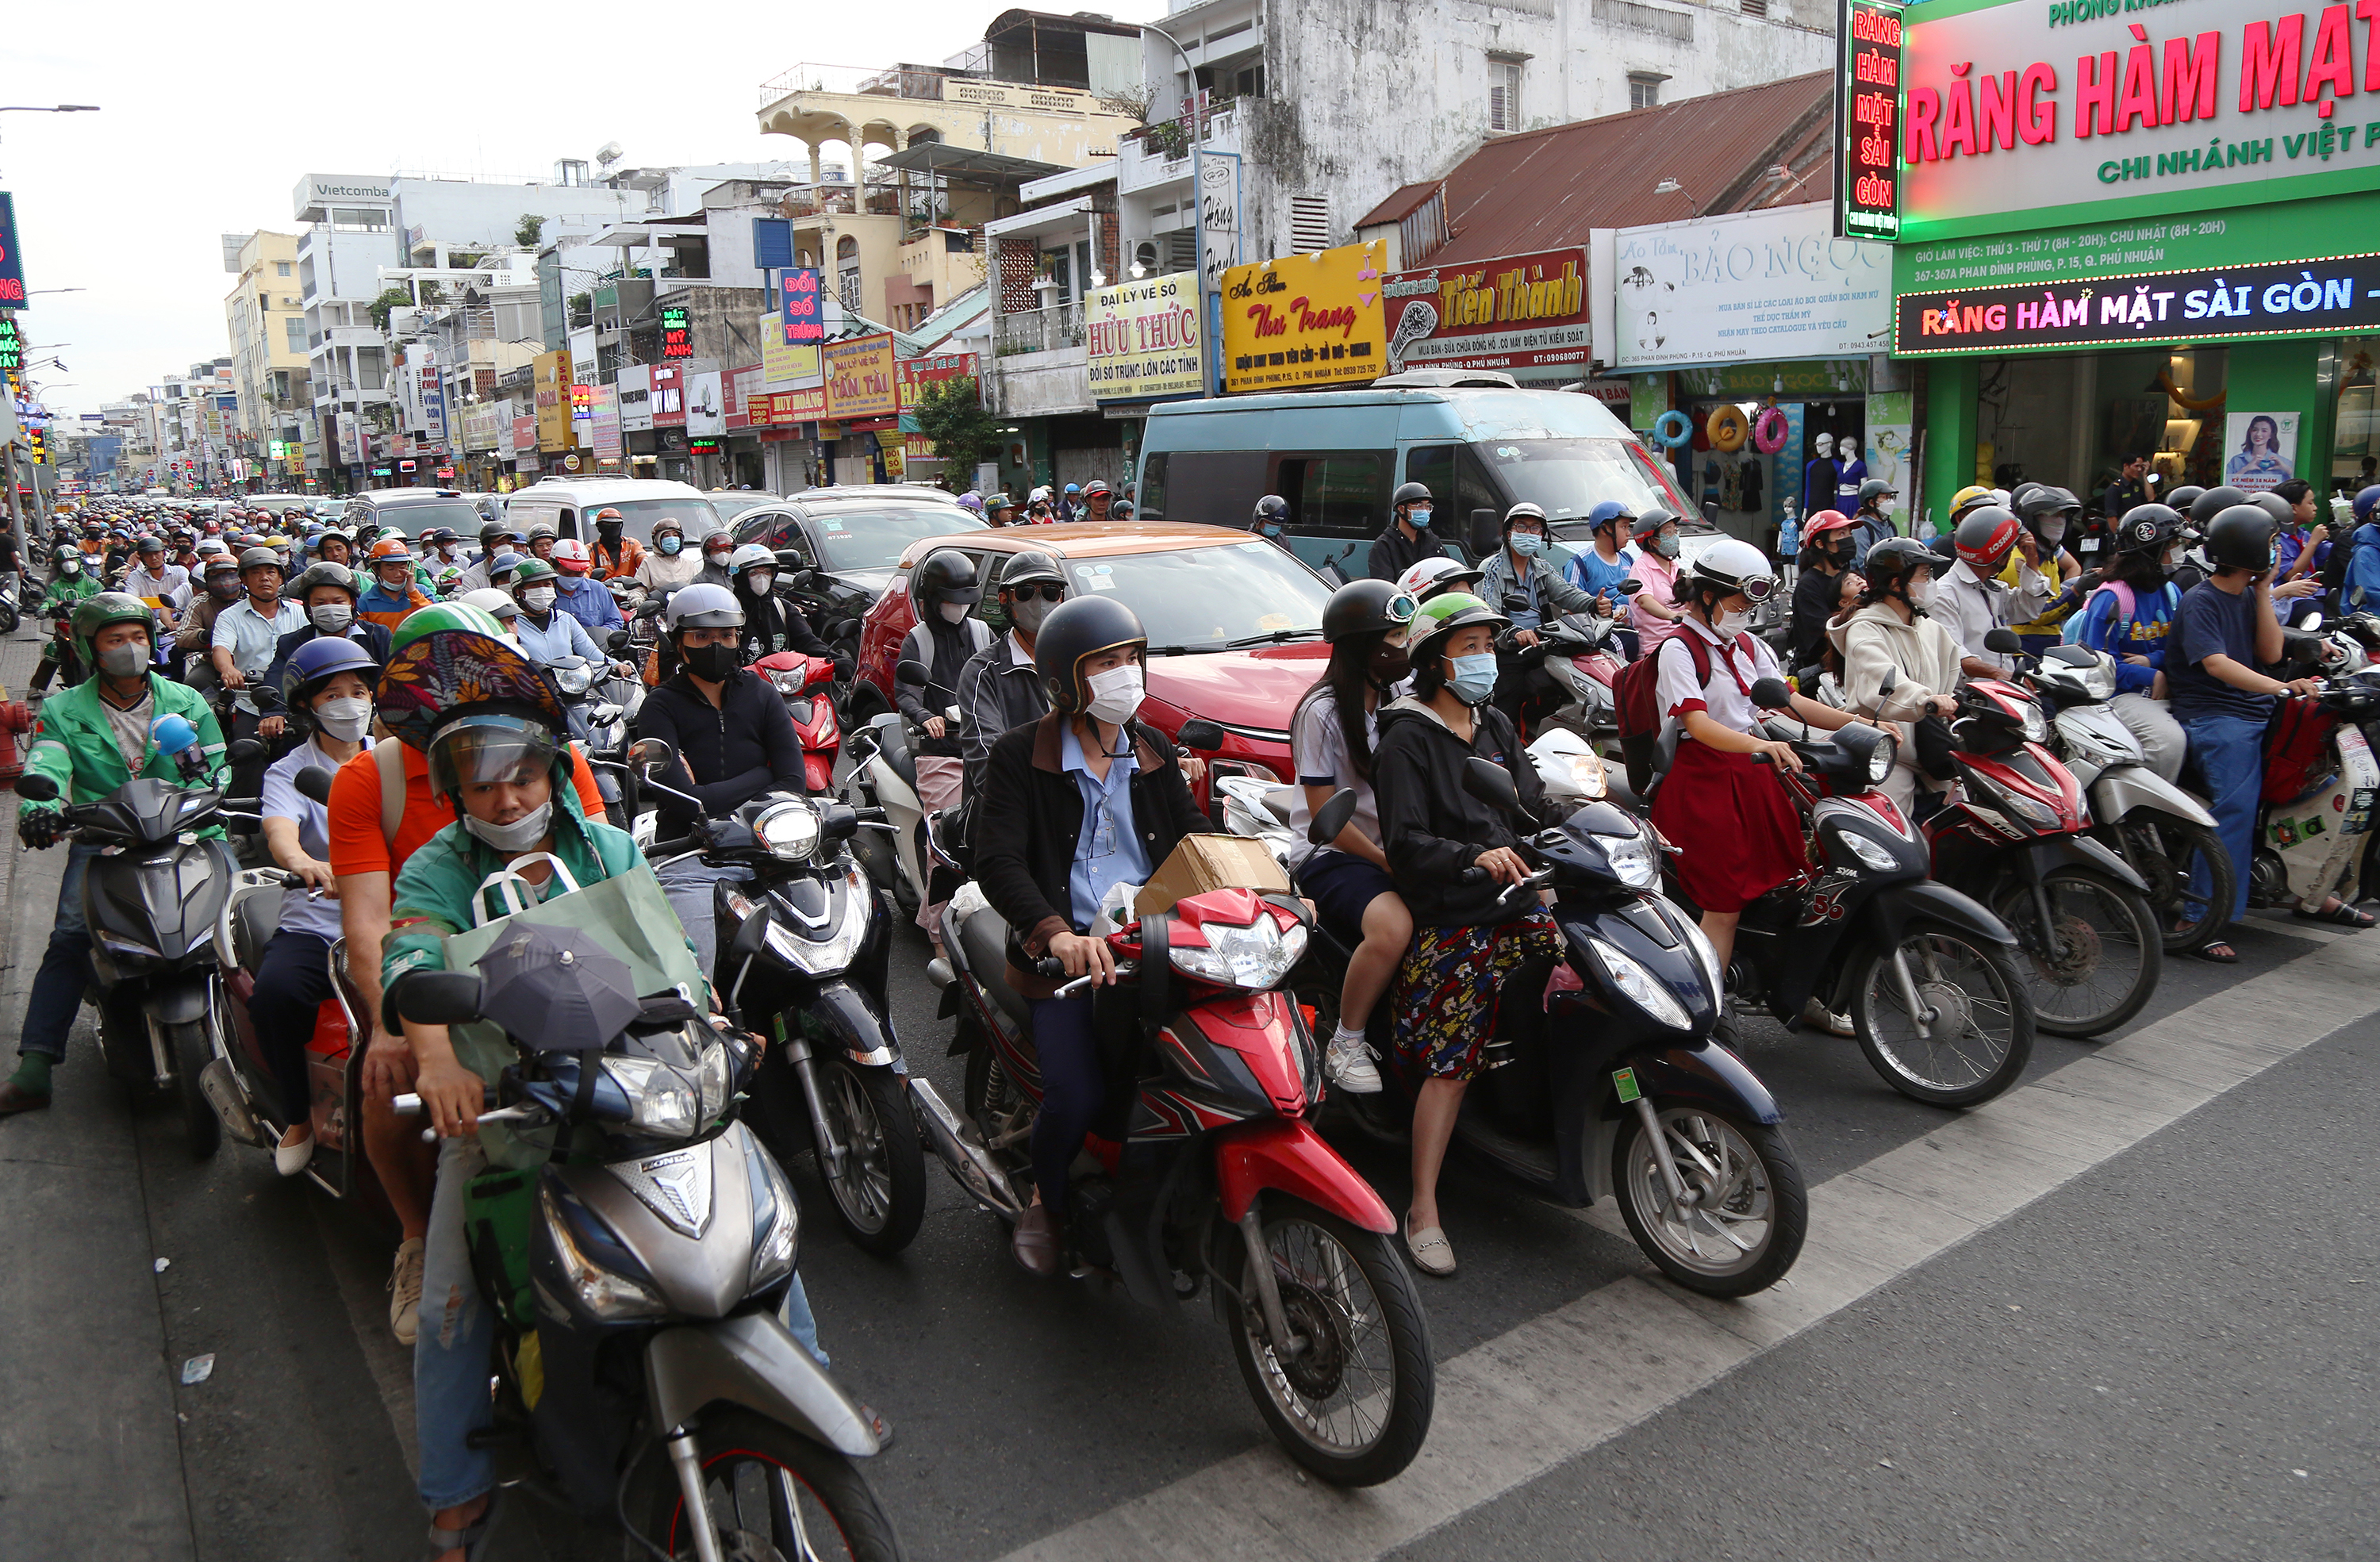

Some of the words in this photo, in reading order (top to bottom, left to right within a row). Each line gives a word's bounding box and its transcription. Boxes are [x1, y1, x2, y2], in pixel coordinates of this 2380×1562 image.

[1853, 8, 1901, 48] RĂNG
[1856, 48, 1897, 87] HÀM
[1906, 62, 2056, 164] RĂNG
[2075, 23, 2220, 138] HÀM
[1856, 91, 1894, 132] MẶT
[1860, 132, 1891, 167] SÀI
[2097, 155, 2150, 183] CHI
[2157, 137, 2273, 176] NHÁNH
[2282, 122, 2355, 160] VIỆT
[317, 184, 391, 197] Vietcomba
[1856, 171, 1892, 207] GÒN
[1204, 195, 1234, 236] Hồng
[1915, 248, 1933, 263] GIỜ
[1935, 246, 1956, 261] LÀM
[1959, 242, 1983, 260] VIỆC:
[1986, 241, 2006, 256] THỨ
[2006, 243, 2013, 255] 3
[2021, 236, 2041, 252] THỨ
[2044, 239, 2051, 251] 7
[2052, 237, 2070, 253] (8H
[2109, 225, 2133, 244] CHỦ
[2136, 225, 2165, 241] NHẬT
[2170, 225, 2190, 240] (8H
[2198, 220, 2225, 236] 20H)
[1680, 228, 1753, 287] BẢO
[1915, 268, 1957, 282] 367-367A
[1960, 264, 1987, 278] PHAN
[1990, 260, 2013, 276] ĐÌNH
[2017, 256, 2055, 274] PHÙNG,
[2085, 254, 2097, 268] Q.
[2100, 249, 2121, 265] PHÚ
[2124, 246, 2164, 263] NHUẬN
[785, 271, 817, 292] ĐỔI
[1230, 271, 1253, 300] Áo
[1101, 294, 1119, 309] ĐẠI
[1123, 287, 1137, 304] LÝ
[1141, 283, 1157, 300] VÉ
[1161, 278, 1177, 297] SỐ
[1438, 270, 1495, 329] Tiến
[1497, 259, 1583, 321] Thành
[1921, 301, 2006, 336] RĂNG
[2017, 292, 2089, 329] HÀM
[2100, 285, 2175, 329] MẶT
[2183, 278, 2253, 319] SÀI
[2262, 271, 2353, 313] GÒN
[663, 309, 685, 319] MẮT
[789, 295, 815, 316] SỐ
[1247, 303, 1287, 339] Thu
[1290, 296, 1357, 338] Trang
[1751, 325, 1768, 335] THEO
[1768, 323, 1807, 333] CATALOGUE
[666, 329, 686, 343] MỸ
[785, 320, 823, 339] TRÚNG
[1088, 311, 1130, 359] HỮU
[1135, 300, 1197, 354] THỨC
[664, 343, 692, 356] ANH
[1418, 346, 1429, 356] MUA
[1510, 336, 1522, 347] MÁY
[1523, 336, 1537, 349] ĐIỆN
[1568, 330, 1583, 343] SOÁT
[422, 367, 436, 378] NHA
[911, 363, 923, 373] ĐẠI
[926, 360, 935, 370] LÝ
[948, 355, 960, 367] SỐ
[1090, 360, 1102, 382] ĐỔI
[1104, 359, 1113, 380] SỐ
[1160, 355, 1176, 374] CÁC
[1178, 352, 1198, 373] TỈNH
[1303, 369, 1312, 379] PHÚ
[1315, 369, 1331, 380] NHUẬN
[1343, 366, 1356, 375] 0939
[1357, 364, 1366, 374] 725
[1367, 363, 1376, 373] 752
[1487, 357, 1510, 367] NHUẬN
[422, 379, 439, 390] KHOA
[830, 372, 861, 399] TẤN
[863, 369, 889, 394] TÀI
[664, 388, 681, 413] ANH
[774, 396, 791, 412] HUY
[793, 390, 823, 409] HOÀNG
[426, 408, 440, 419] SƠN
[886, 447, 900, 458] ĐỔI
[889, 457, 900, 467] SỐ
[887, 467, 904, 477] TRÚNG
[1989, 525, 2013, 555] LOSHIP
[143, 857, 173, 865] HONDA
[1836, 866, 1858, 877] SYM
[788, 877, 813, 885] HONDA
[643, 1153, 696, 1172] HONDA
